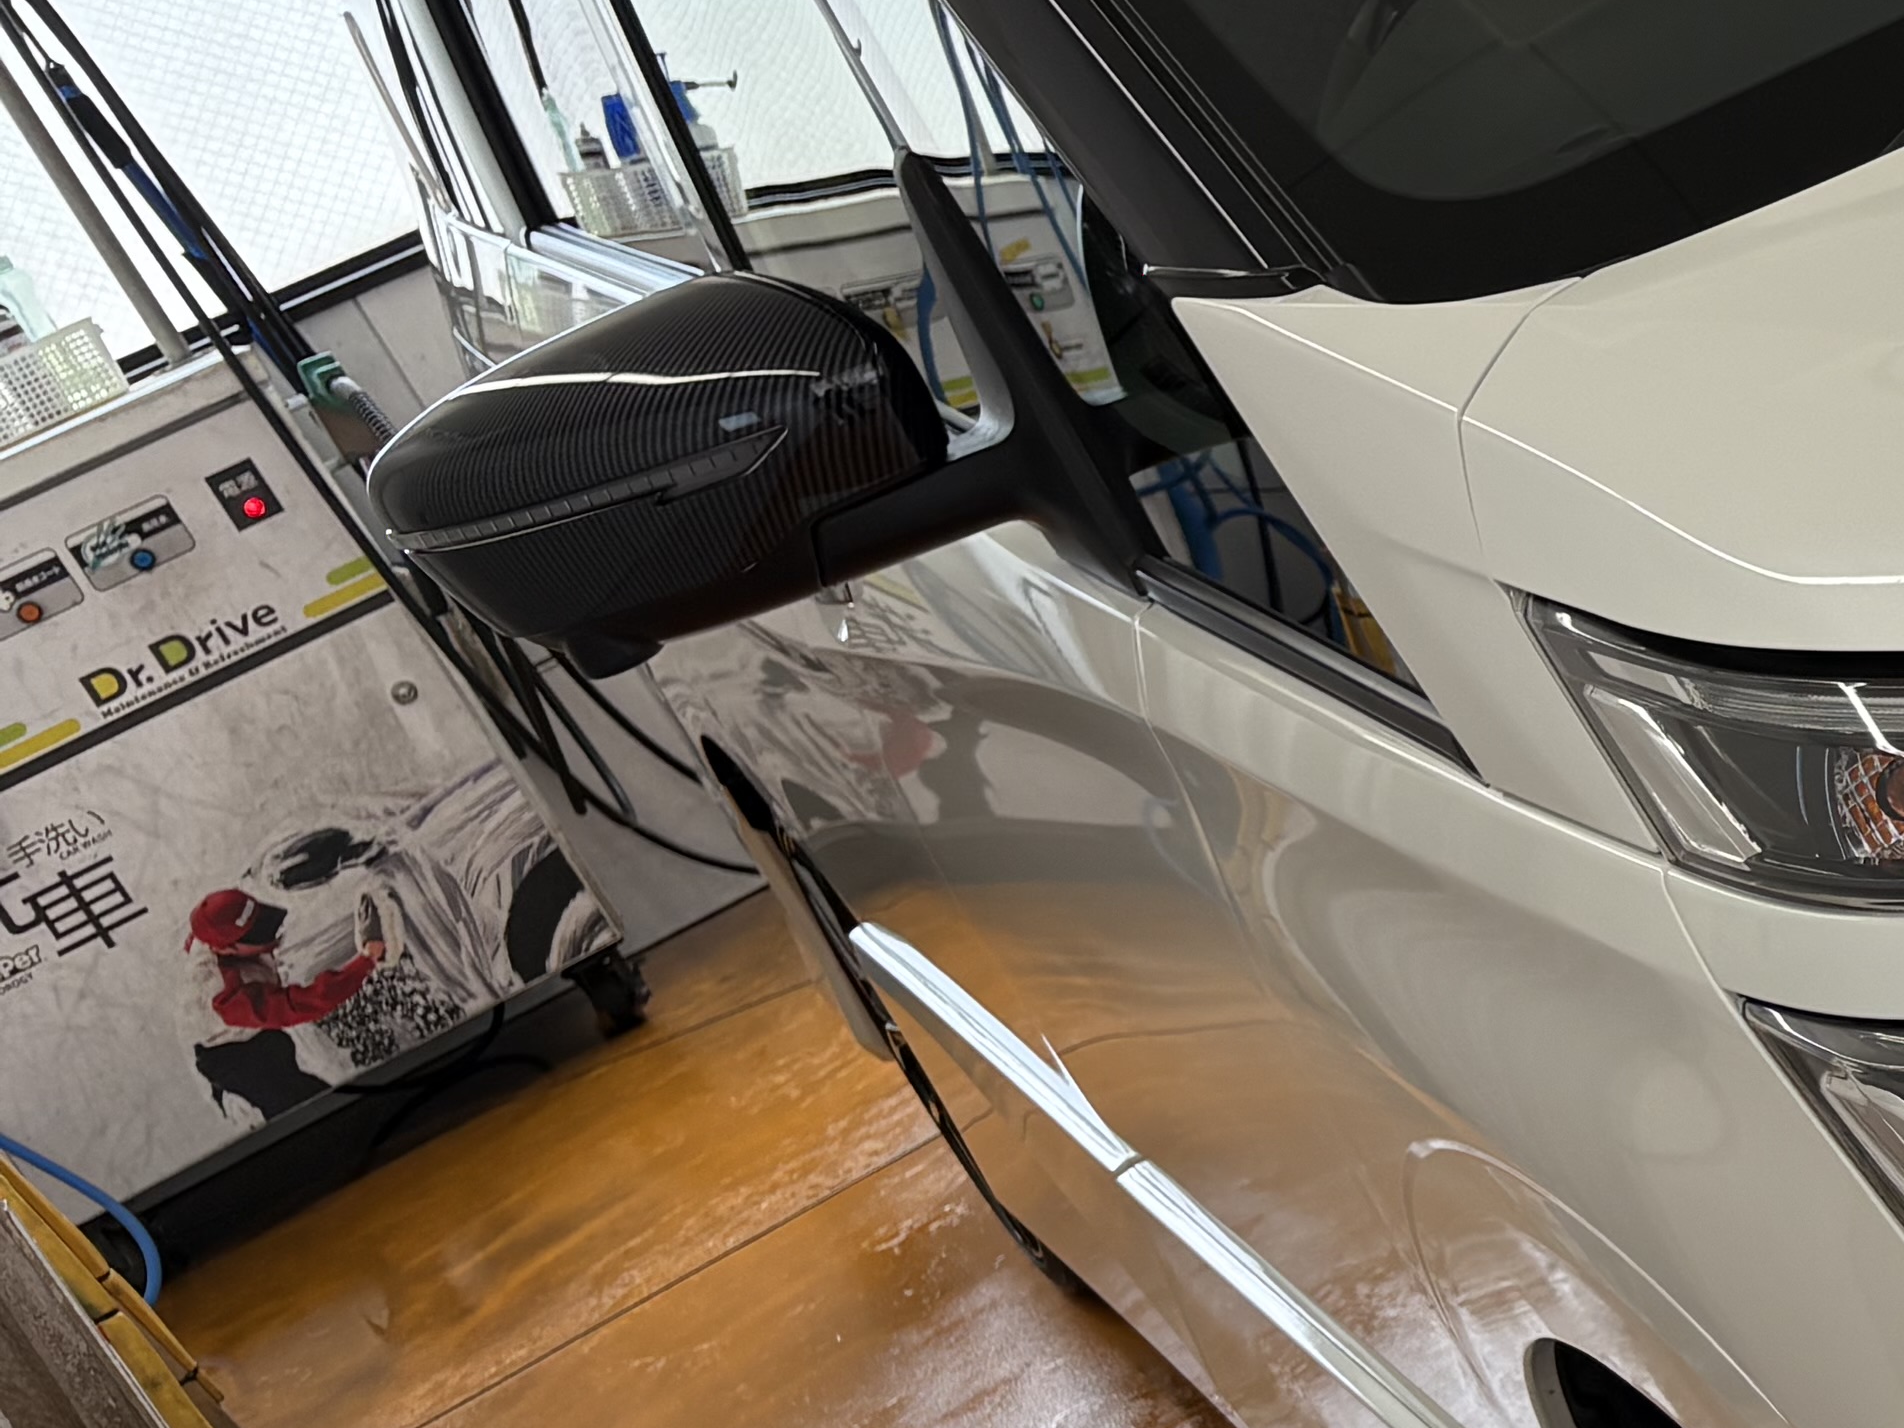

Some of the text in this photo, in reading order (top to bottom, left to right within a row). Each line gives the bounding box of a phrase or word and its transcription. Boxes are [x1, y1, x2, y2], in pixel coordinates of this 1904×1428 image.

[78, 604, 279, 708] Dr. Drive
[6, 810, 105, 868] 手洗い
[0, 943, 42, 984] Per
